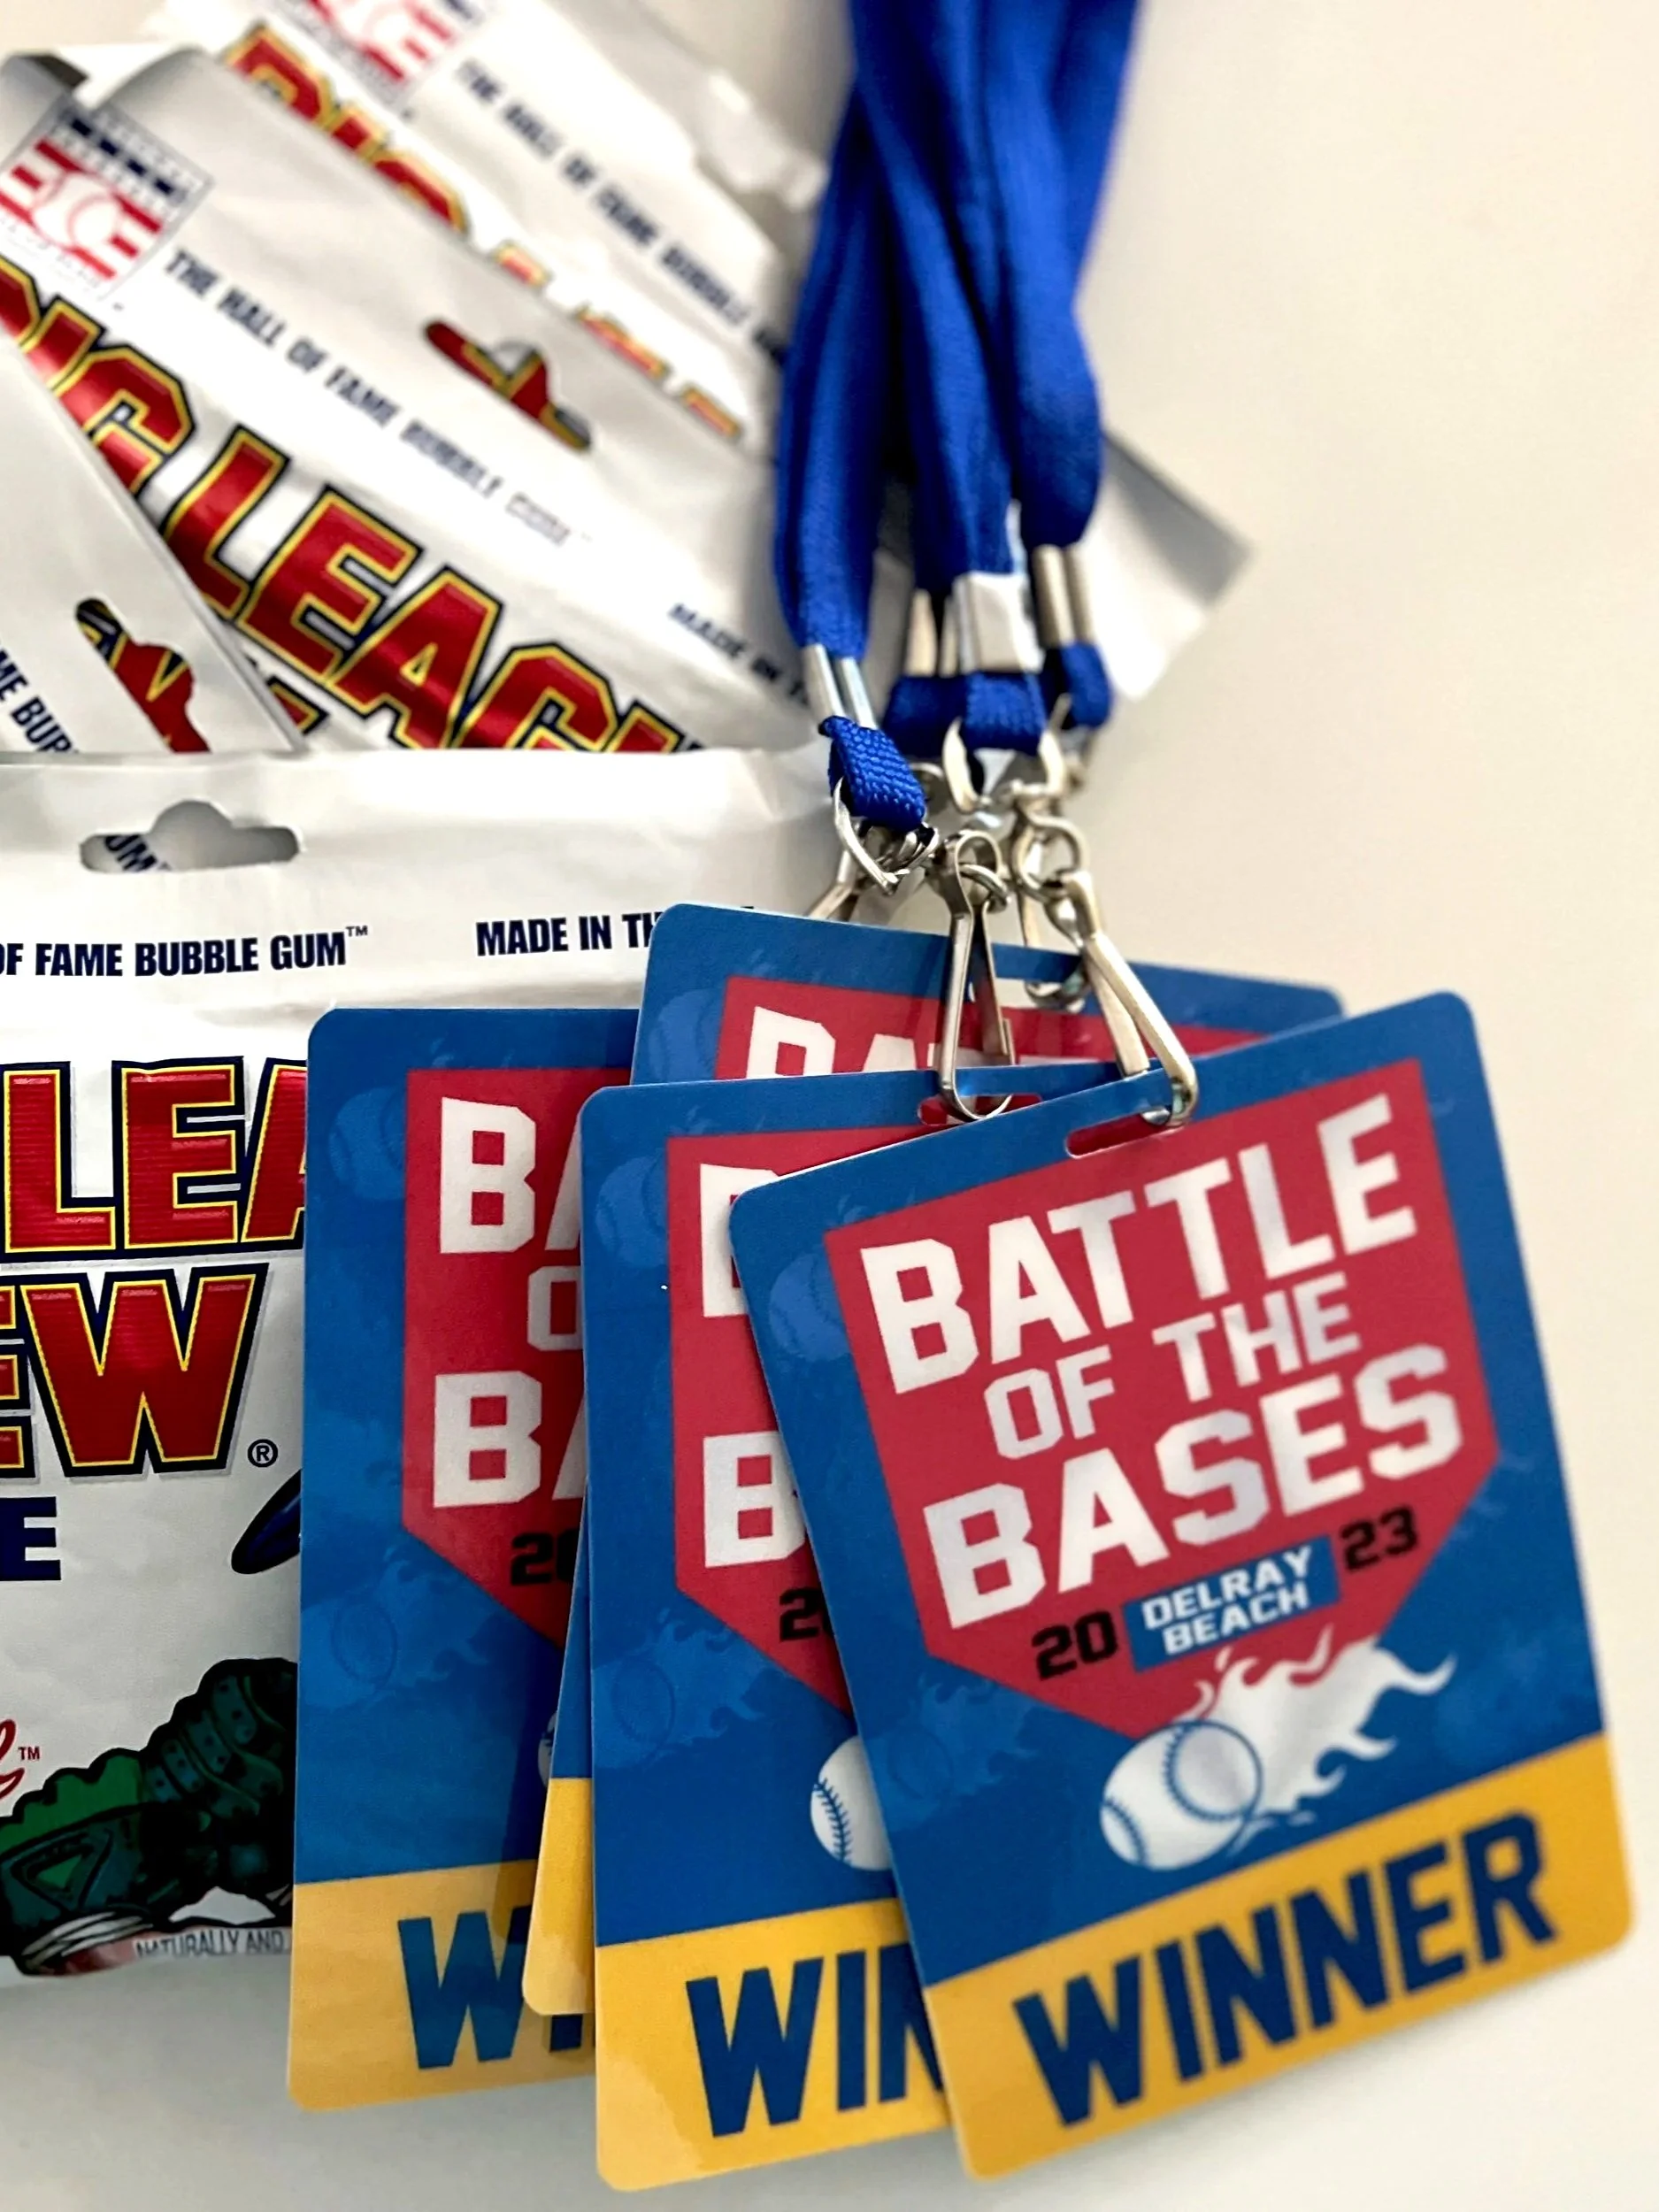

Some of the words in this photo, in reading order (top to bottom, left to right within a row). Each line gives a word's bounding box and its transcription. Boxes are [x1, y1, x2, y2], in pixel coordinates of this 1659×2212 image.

[324, 365, 397, 428] FAME
[35, 942, 123, 977] FAME
[134, 937, 259, 977] BUBBLE
[476, 917, 569, 956] MADE
[579, 914, 612, 951] IN
[860, 1093, 1417, 1395] BATTLE
[983, 1345, 1116, 1461] OF
[1151, 1271, 1361, 1403] THE
[922, 1343, 1464, 1630] BASES
[1340, 1504, 1421, 1574] 23
[1141, 1544, 1314, 1632] DELRAY
[1161, 1582, 1310, 1657] BEACH
[1031, 1609, 1119, 1681] 20
[136, 1930, 240, 1958] NATURALLY
[246, 1929, 284, 1955] AND
[1011, 1809, 1558, 2129] WINNER
